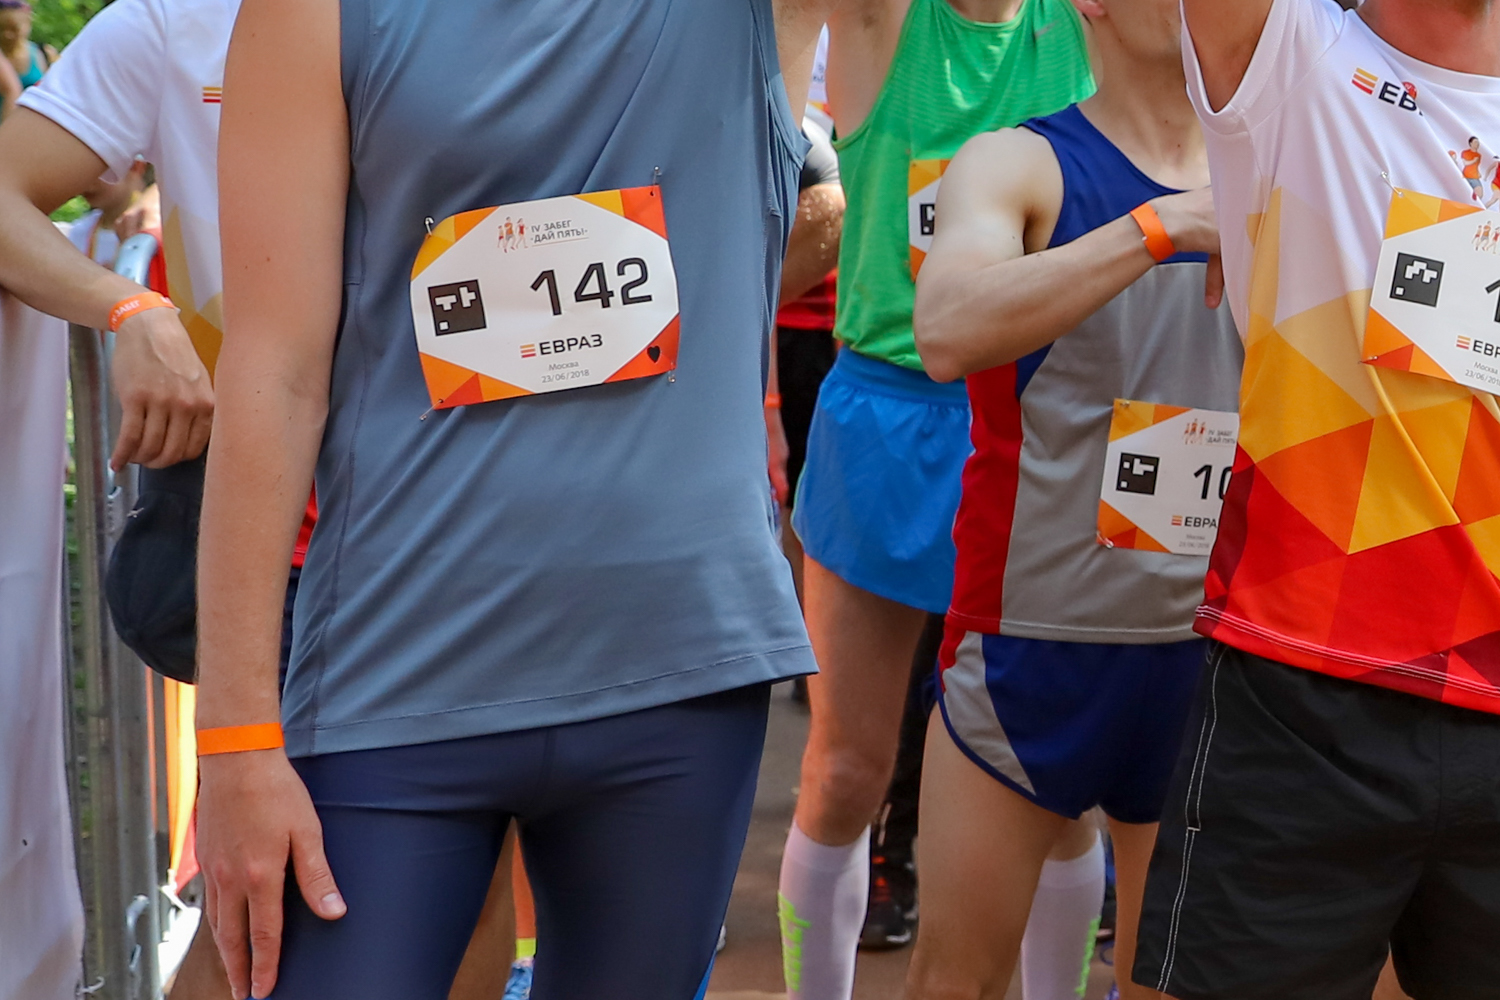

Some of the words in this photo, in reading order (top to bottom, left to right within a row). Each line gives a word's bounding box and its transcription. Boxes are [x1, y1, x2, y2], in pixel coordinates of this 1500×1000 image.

[531, 225, 541, 233] IV
[544, 220, 572, 231] ЗАБЕГ
[530, 257, 653, 316] 142
[539, 334, 604, 356] ЕВРАЗ
[548, 361, 579, 371] Москва
[1473, 361, 1498, 375] Москва
[1184, 516, 1218, 528] ЕВРА
